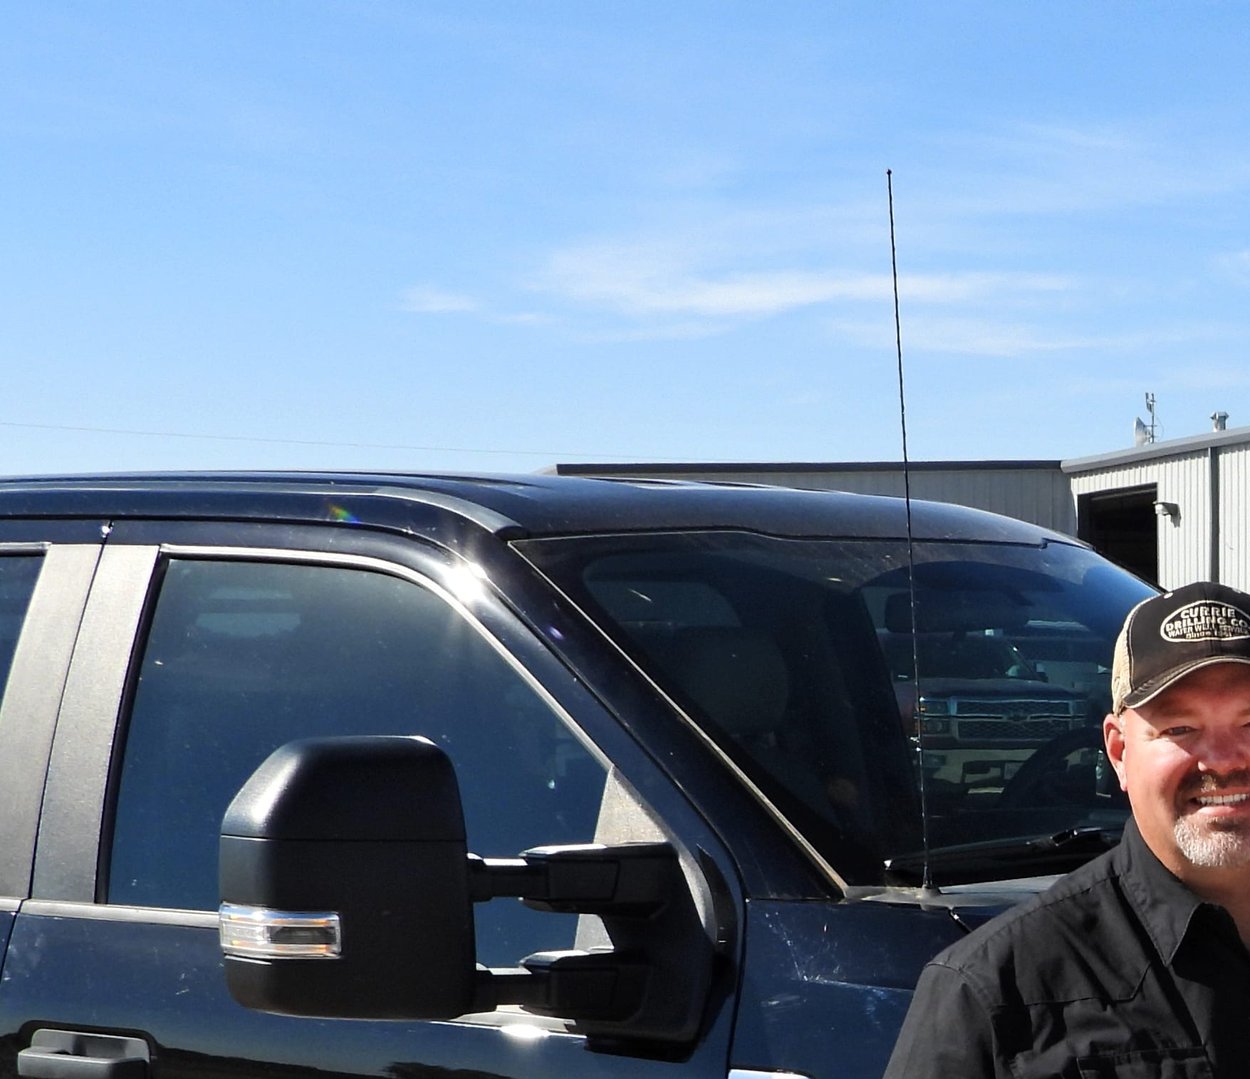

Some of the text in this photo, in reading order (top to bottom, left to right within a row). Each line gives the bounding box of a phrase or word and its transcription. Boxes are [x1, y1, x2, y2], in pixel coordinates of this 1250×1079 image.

[1180, 606, 1236, 619] CURRIE
[1165, 616, 1250, 632] DRILLING CO.
